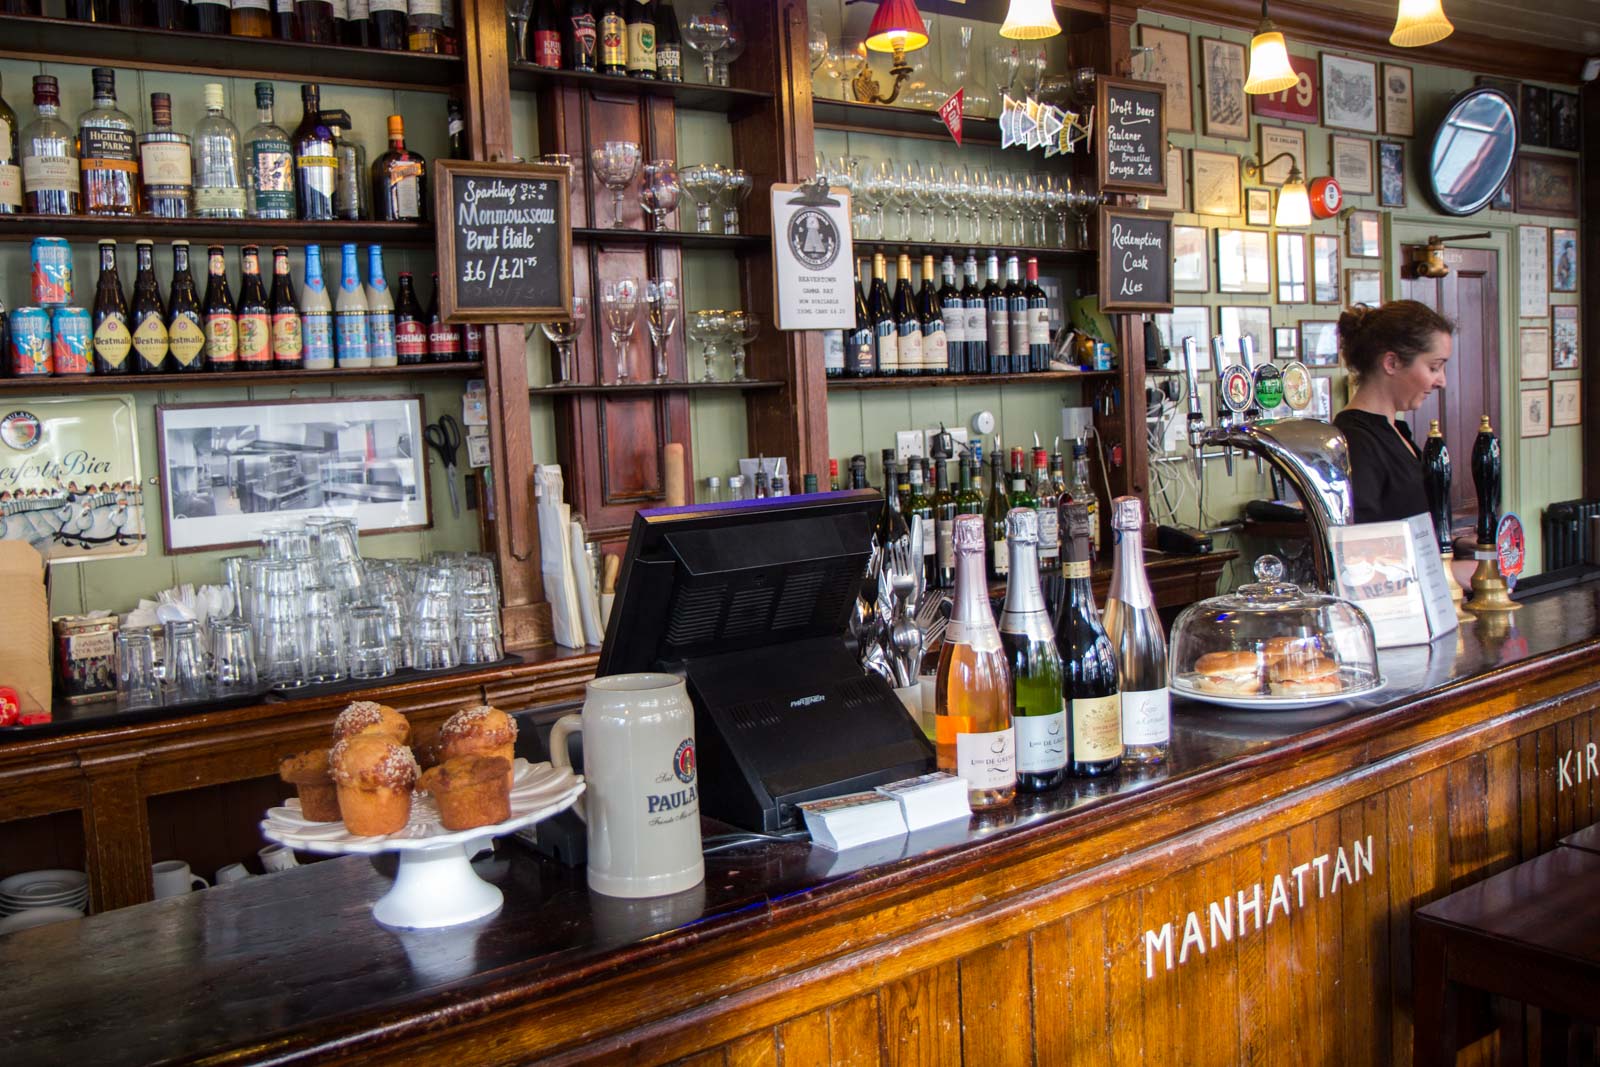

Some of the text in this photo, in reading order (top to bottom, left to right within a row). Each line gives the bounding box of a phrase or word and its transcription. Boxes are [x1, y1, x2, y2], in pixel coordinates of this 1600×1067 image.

[1108, 125, 1141, 140] Paulaner
[102, 141, 124, 150] PARK
[1109, 161, 1152, 179] Brugse Zot
[464, 180, 517, 205] Sparkling
[459, 202, 555, 226] Monmousseau
[1112, 223, 1161, 250] Redemption
[1123, 251, 1148, 272] Cask
[1120, 277, 1143, 295] Ales
[60, 449, 111, 475] Bier
[1559, 742, 1599, 791] KIR
[1145, 835, 1373, 978] MANHATTAN
